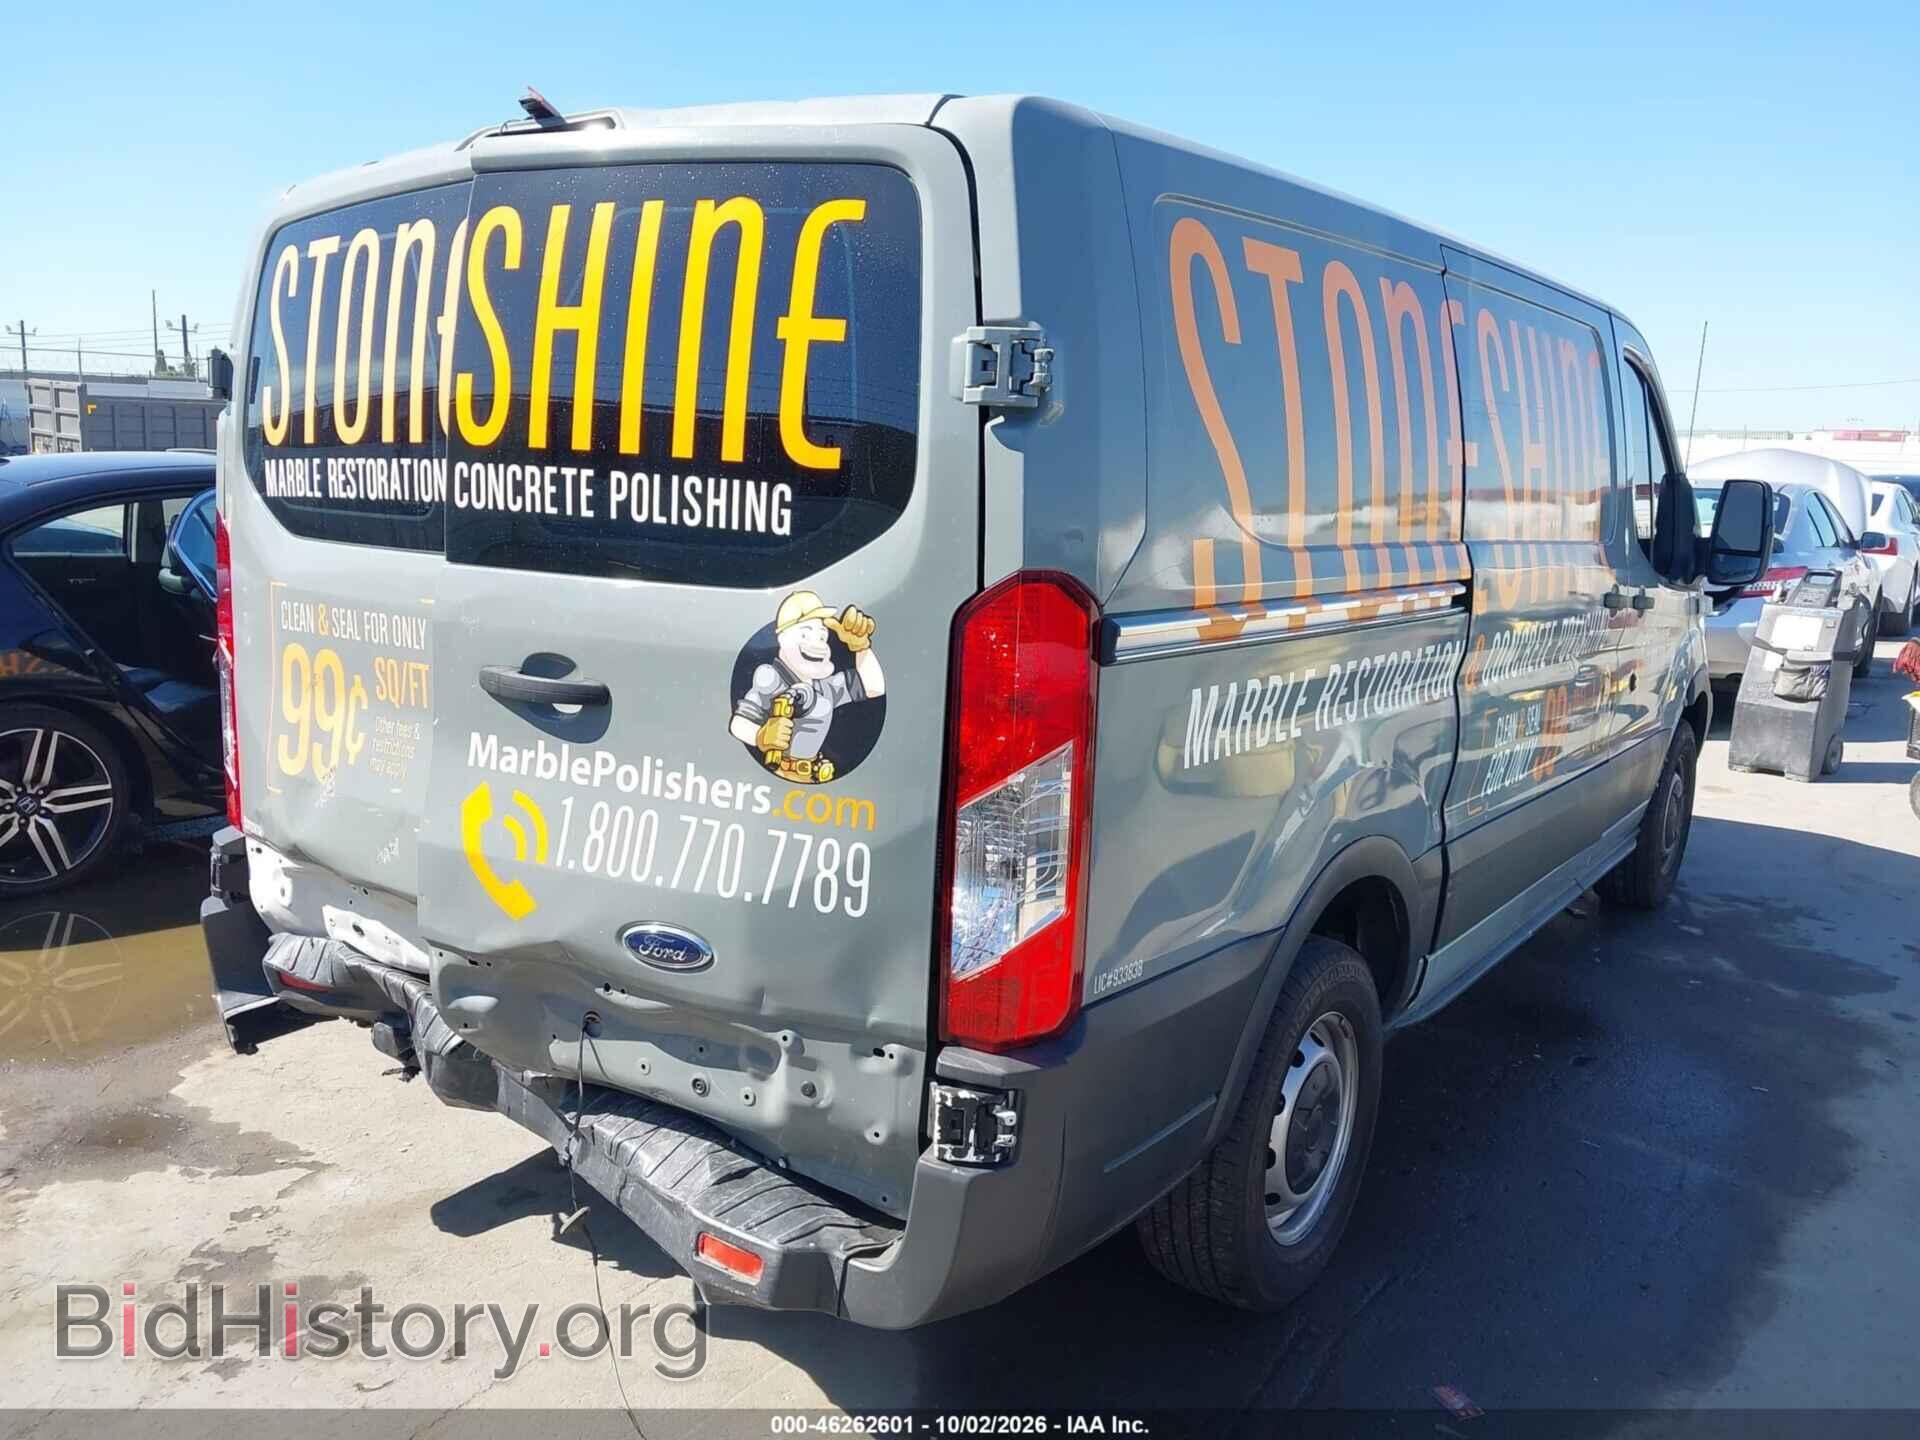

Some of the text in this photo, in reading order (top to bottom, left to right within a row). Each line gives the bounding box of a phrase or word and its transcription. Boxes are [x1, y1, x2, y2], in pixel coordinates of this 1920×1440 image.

[265, 458, 792, 535] MARBLE RESTORATION CONCRETE POLISHING
[281, 601, 426, 650] CLEAN & SEAL FOR ONLY
[374, 657, 430, 709] SQ/FT
[1184, 669, 1317, 769] MARBLE
[1314, 640, 1467, 732] RESTORATION
[468, 733, 877, 832] MarblePolishers.com
[554, 795, 873, 918] 1.800.770.7789
[639, 935, 687, 960] Ford
